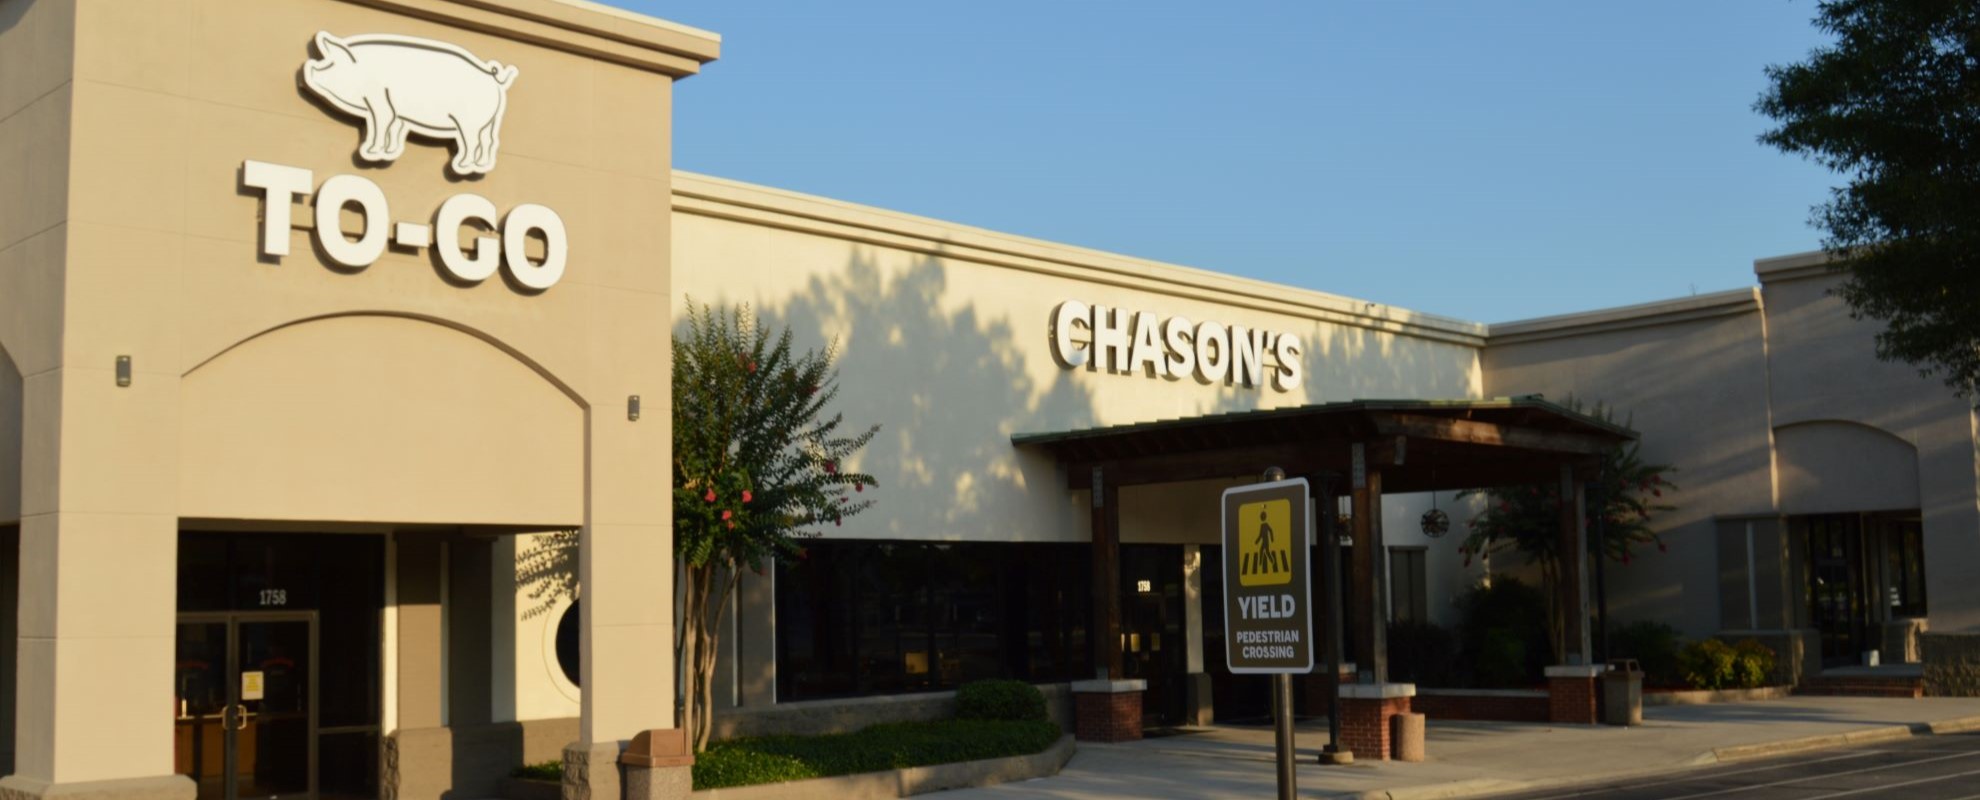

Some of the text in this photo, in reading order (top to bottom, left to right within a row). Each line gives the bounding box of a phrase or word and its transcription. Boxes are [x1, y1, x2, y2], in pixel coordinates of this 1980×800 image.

[243, 159, 568, 289] TO-GO
[1055, 300, 1301, 390] CHASON'S
[259, 589, 287, 605] 1758
[1238, 594, 1296, 619] YIELD
[1236, 630, 1299, 643] PEDESTRIAN
[1242, 646, 1294, 658] CROSSING
